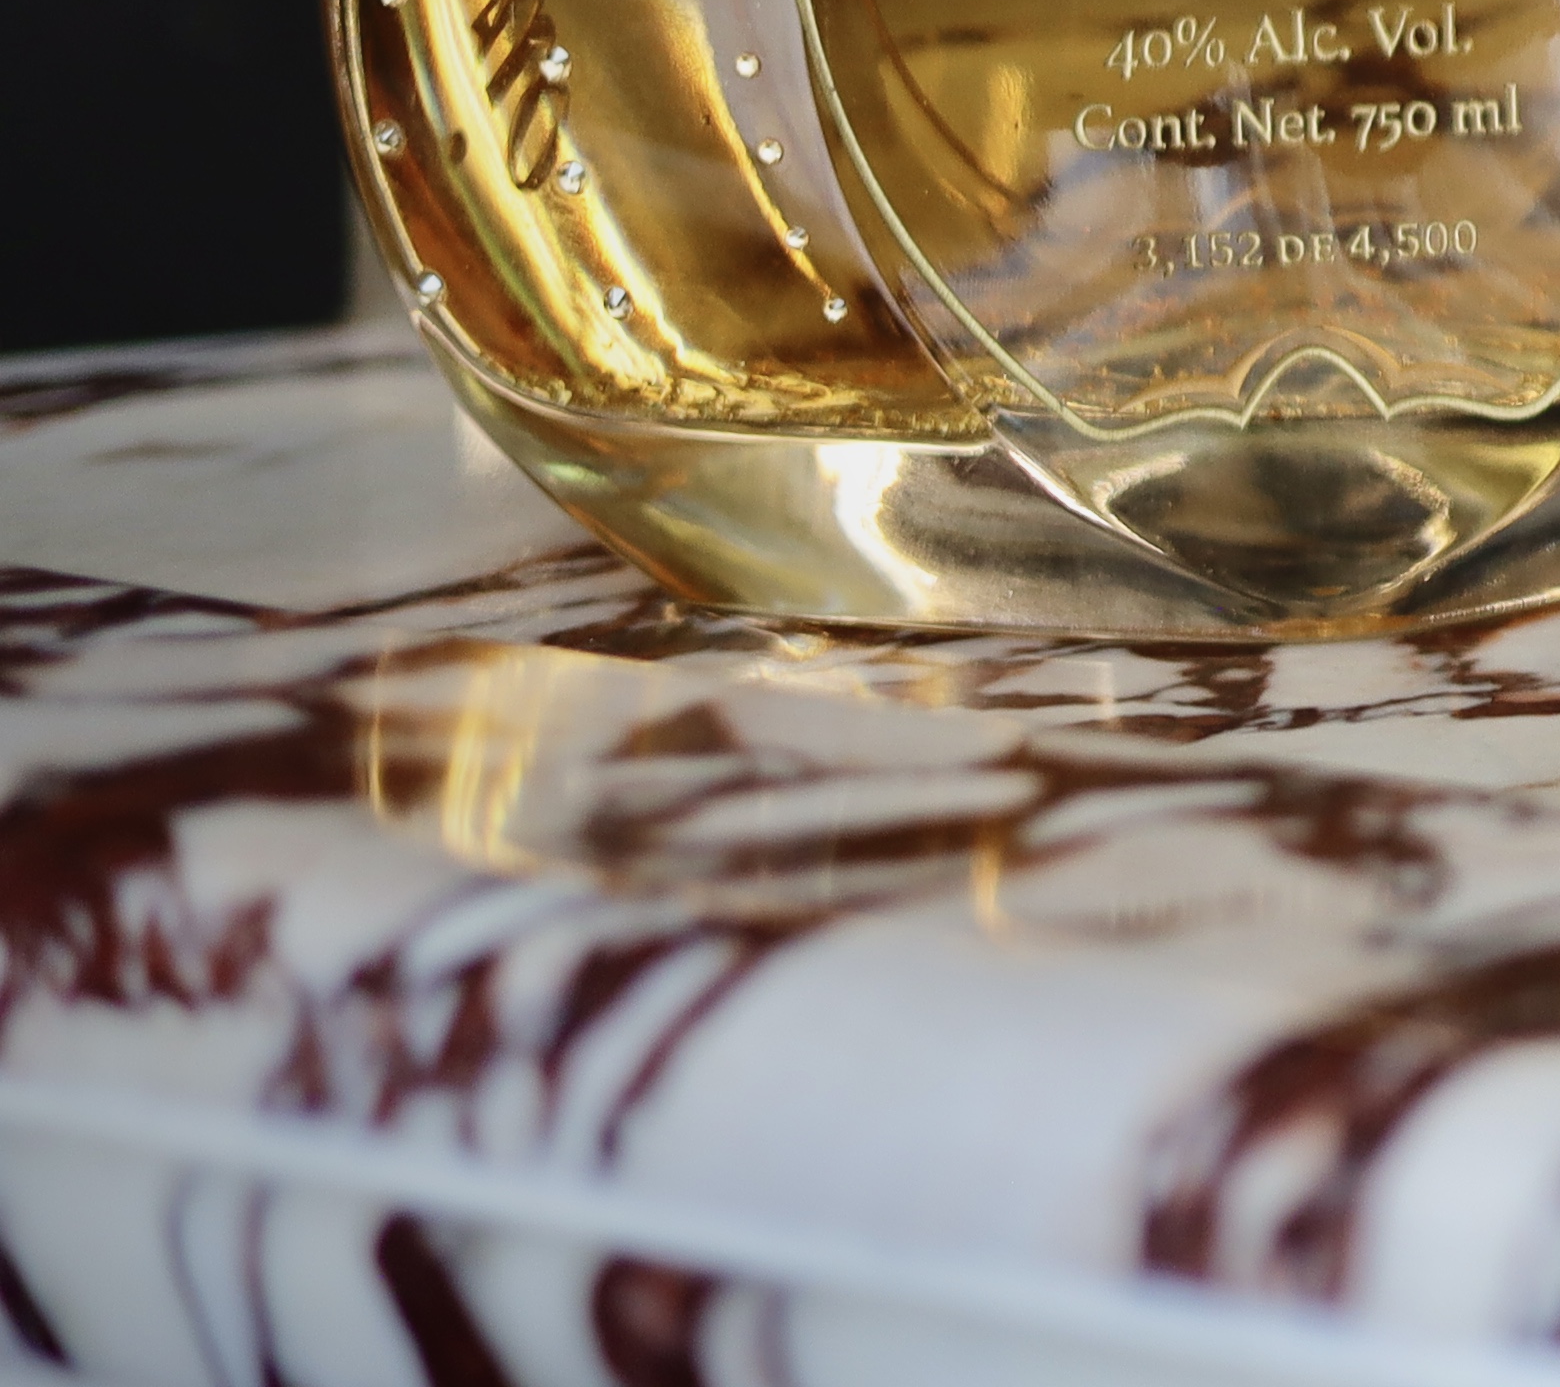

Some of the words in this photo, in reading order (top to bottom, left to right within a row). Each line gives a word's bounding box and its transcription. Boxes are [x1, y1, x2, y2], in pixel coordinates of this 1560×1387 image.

[1104, 15, 1226, 82] 40%
[1247, 7, 1351, 65] Alc.
[1368, 3, 1474, 59] Vol.
[1073, 102, 1216, 153] Cont.
[1232, 102, 1336, 148] Net.
[1351, 103, 1438, 153] 750
[1452, 85, 1521, 137] ml
[1131, 231, 1264, 279] 3,152
[1277, 233, 1335, 264] DE
[1349, 219, 1478, 267] 4,500
